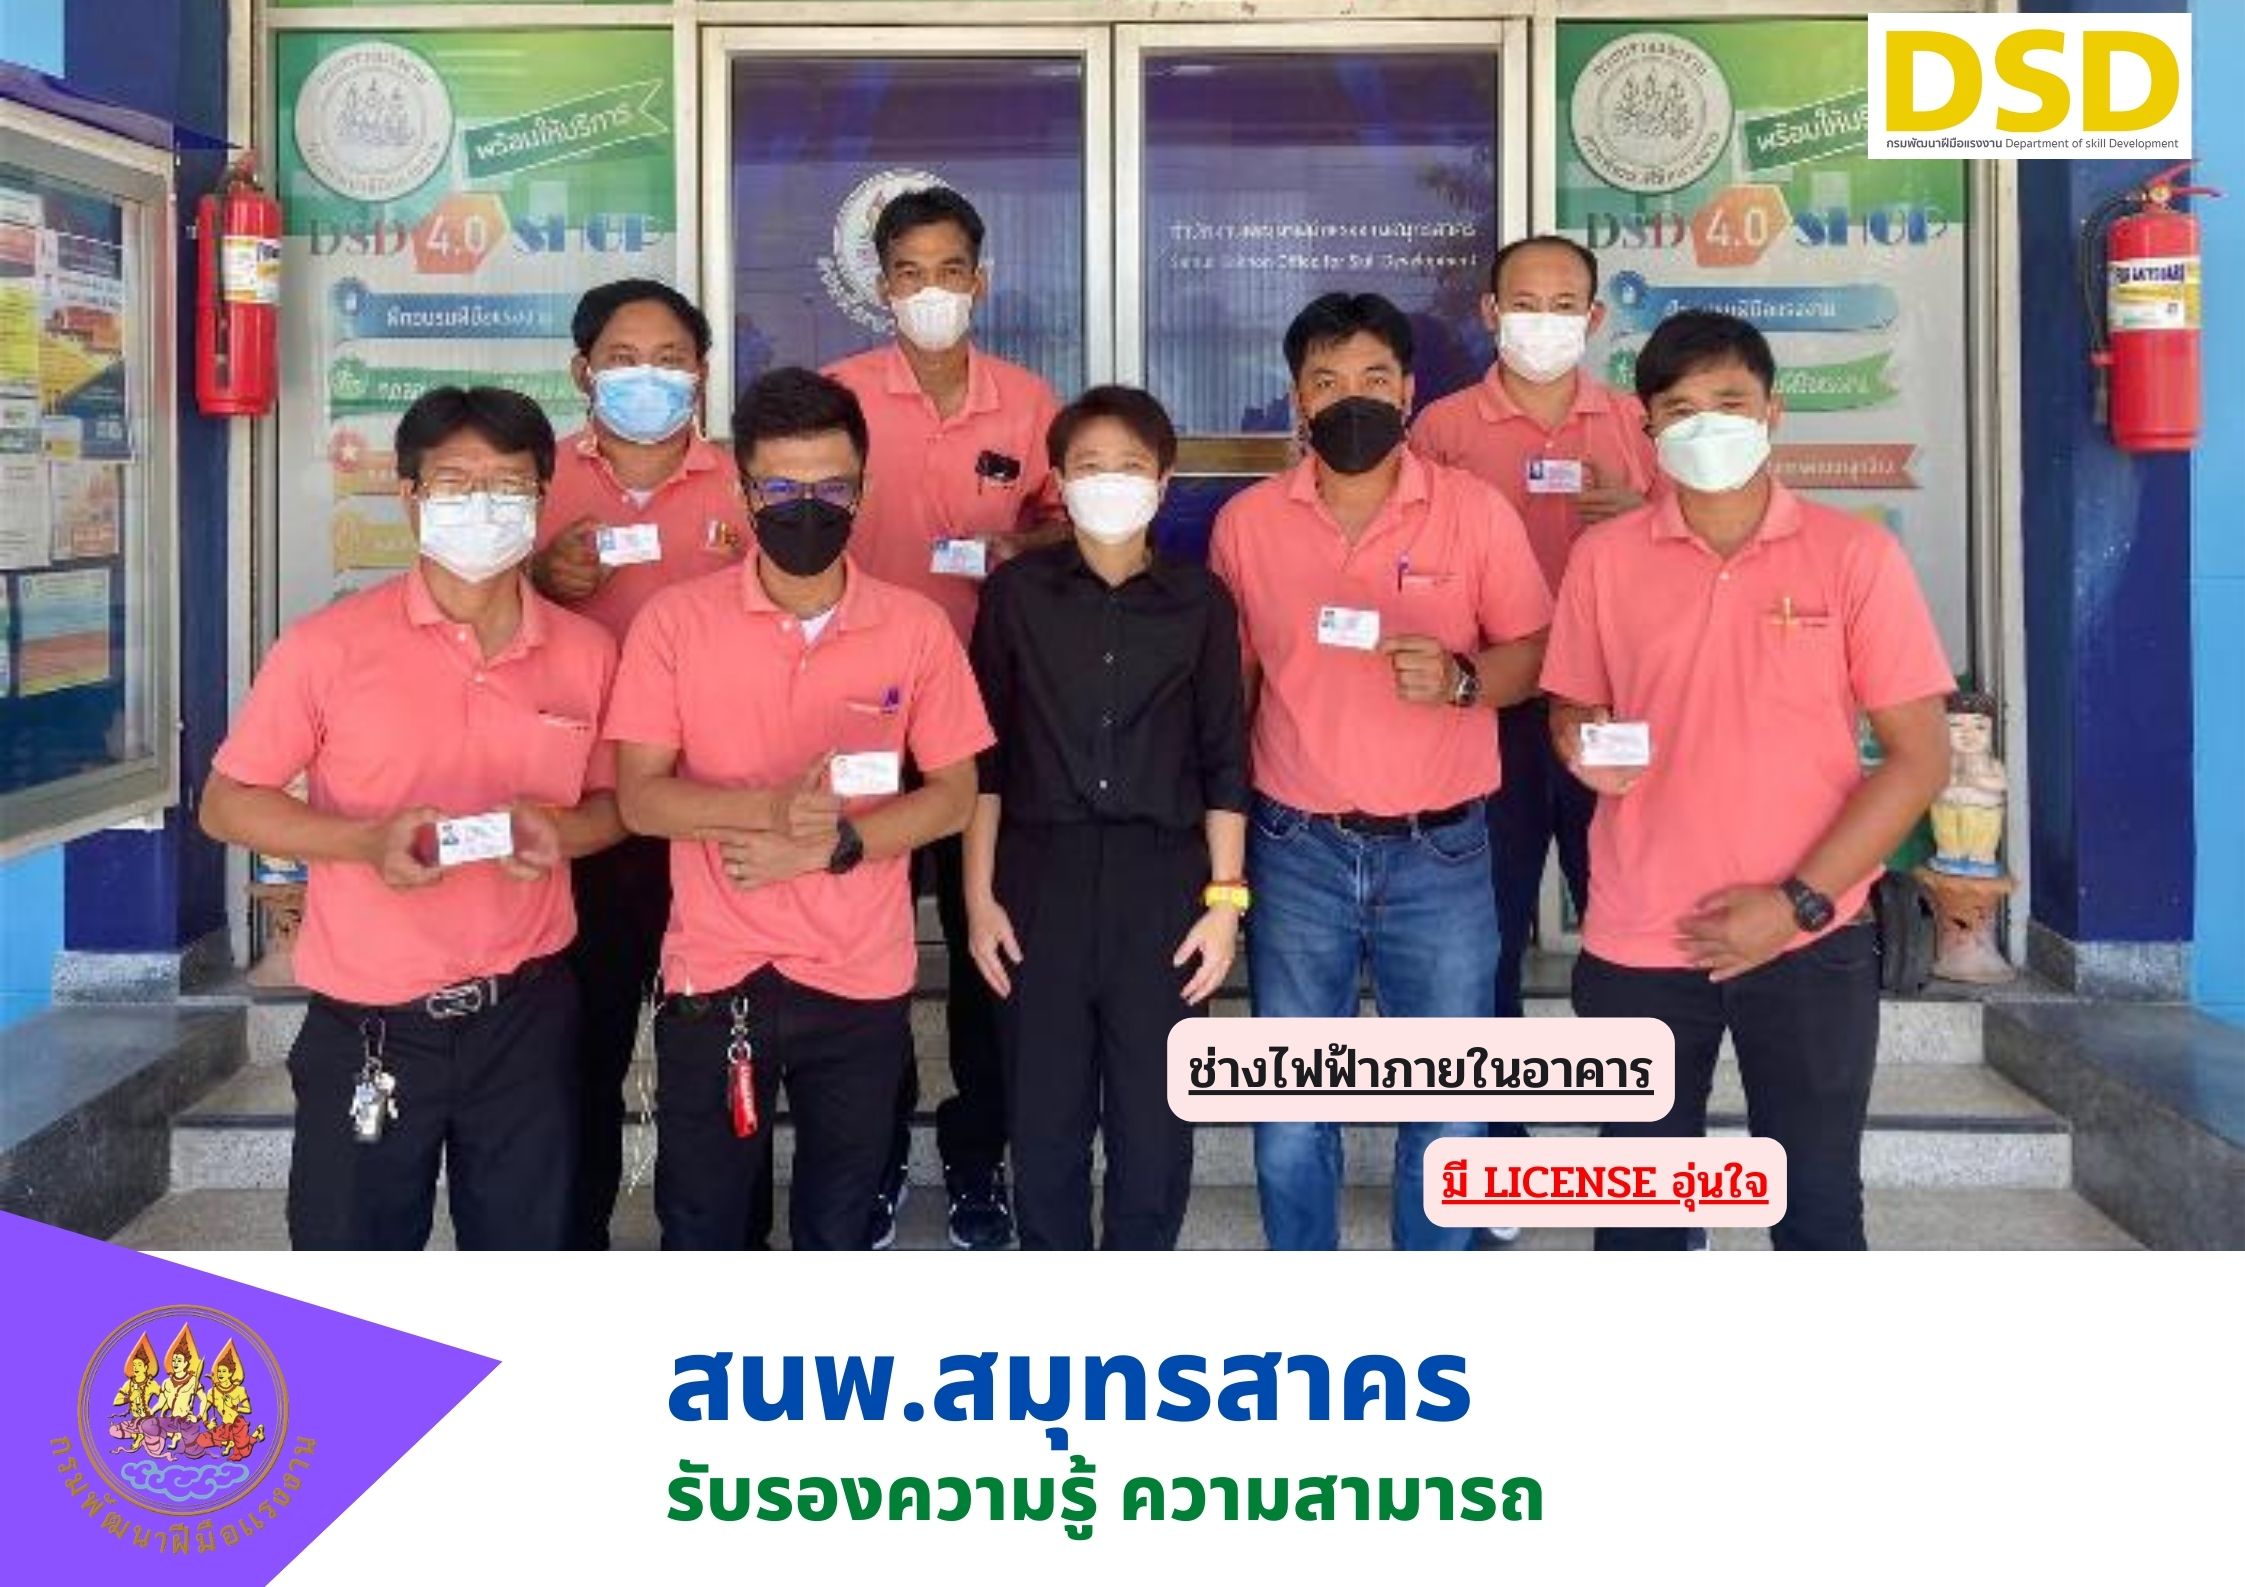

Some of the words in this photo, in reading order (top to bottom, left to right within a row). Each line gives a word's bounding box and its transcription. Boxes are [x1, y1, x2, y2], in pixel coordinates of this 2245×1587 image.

[426, 215, 487, 256] 4.0
[1587, 211, 1685, 249] DSD
[1705, 209, 1768, 247] 4.0
